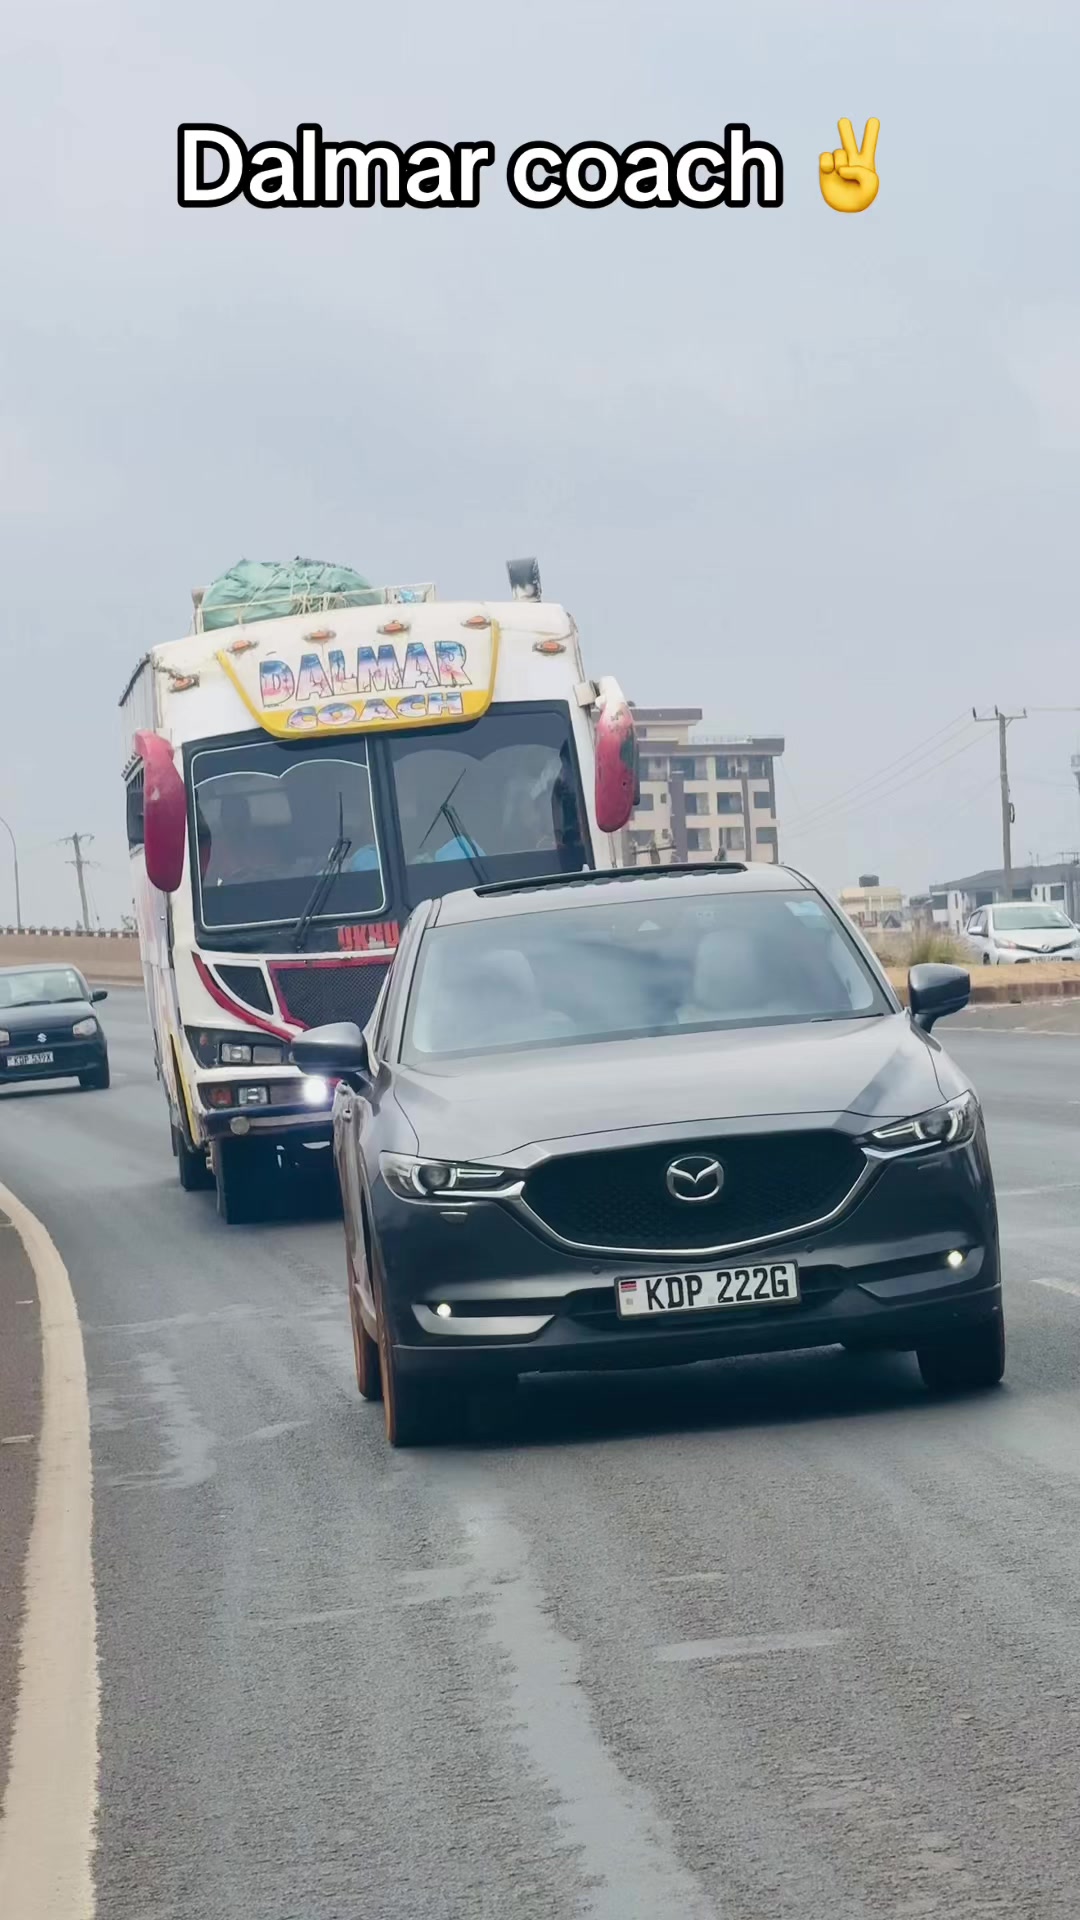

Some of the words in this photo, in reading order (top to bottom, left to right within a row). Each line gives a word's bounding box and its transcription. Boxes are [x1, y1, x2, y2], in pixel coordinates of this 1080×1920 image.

[259, 641, 472, 707] DALMAR
[286, 692, 464, 729] COACH
[645, 1274, 703, 1310] KDP
[716, 1265, 790, 1304] 222G
